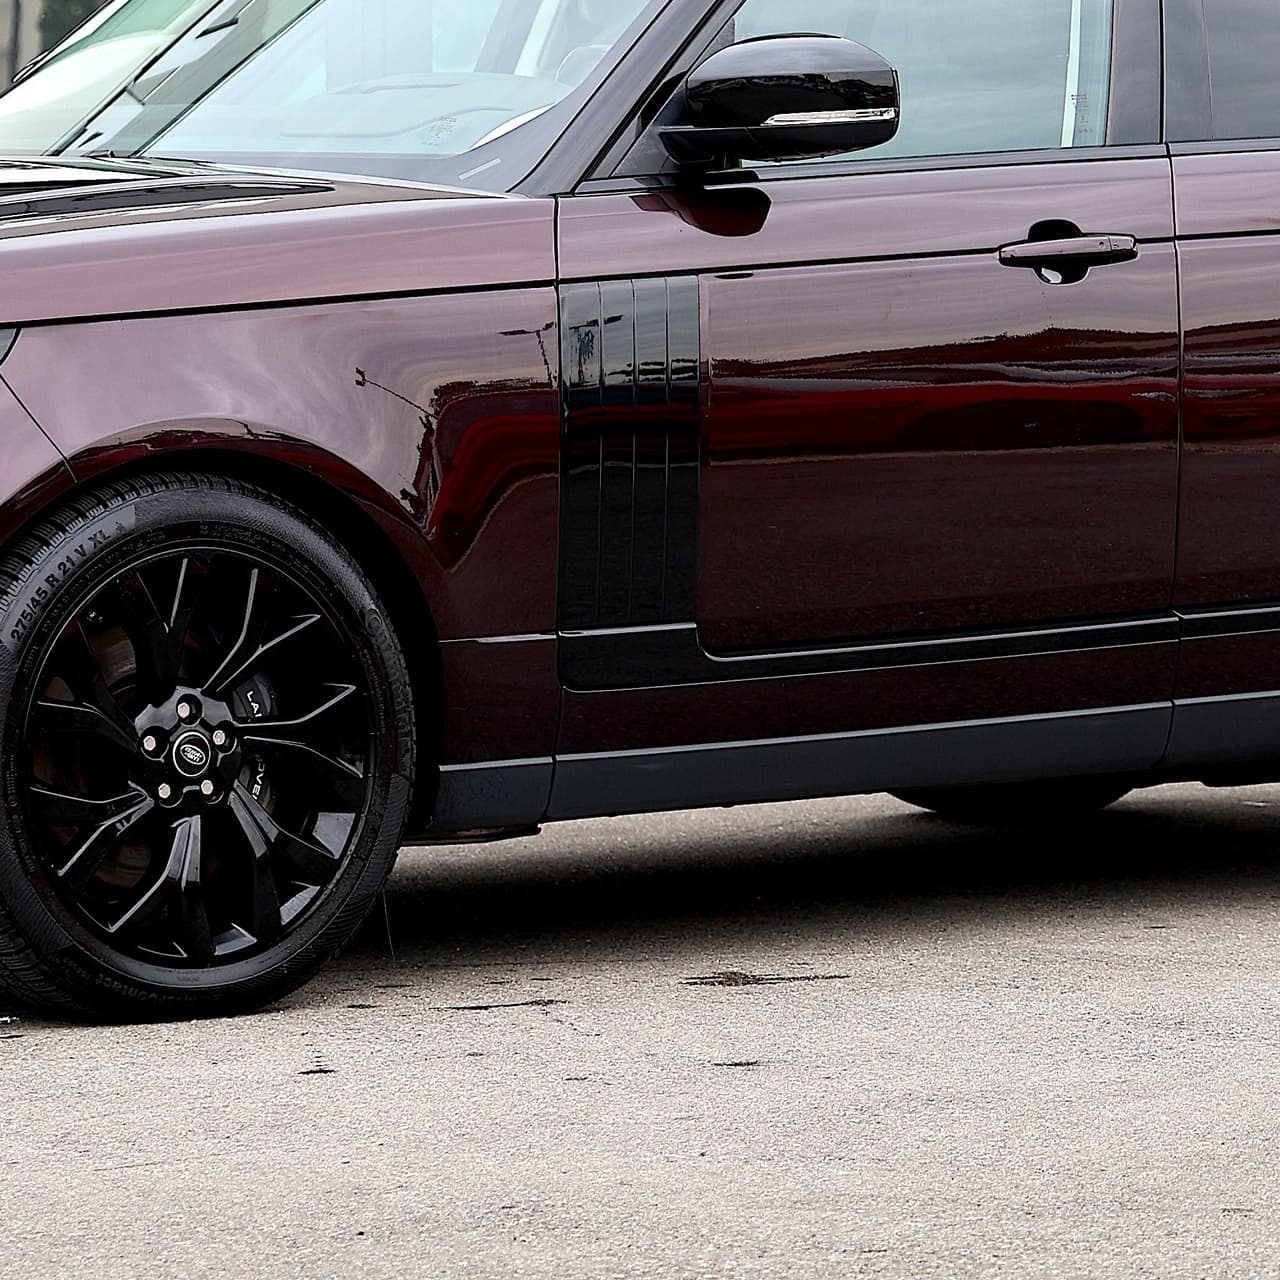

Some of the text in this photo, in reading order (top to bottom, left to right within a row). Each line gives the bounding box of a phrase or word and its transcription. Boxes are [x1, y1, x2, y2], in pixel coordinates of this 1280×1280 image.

[10, 586, 49, 640] 275/45
[44, 573, 60, 589] R
[57, 555, 76, 577] 21
[74, 543, 88, 558] V
[87, 529, 112, 549] XL
